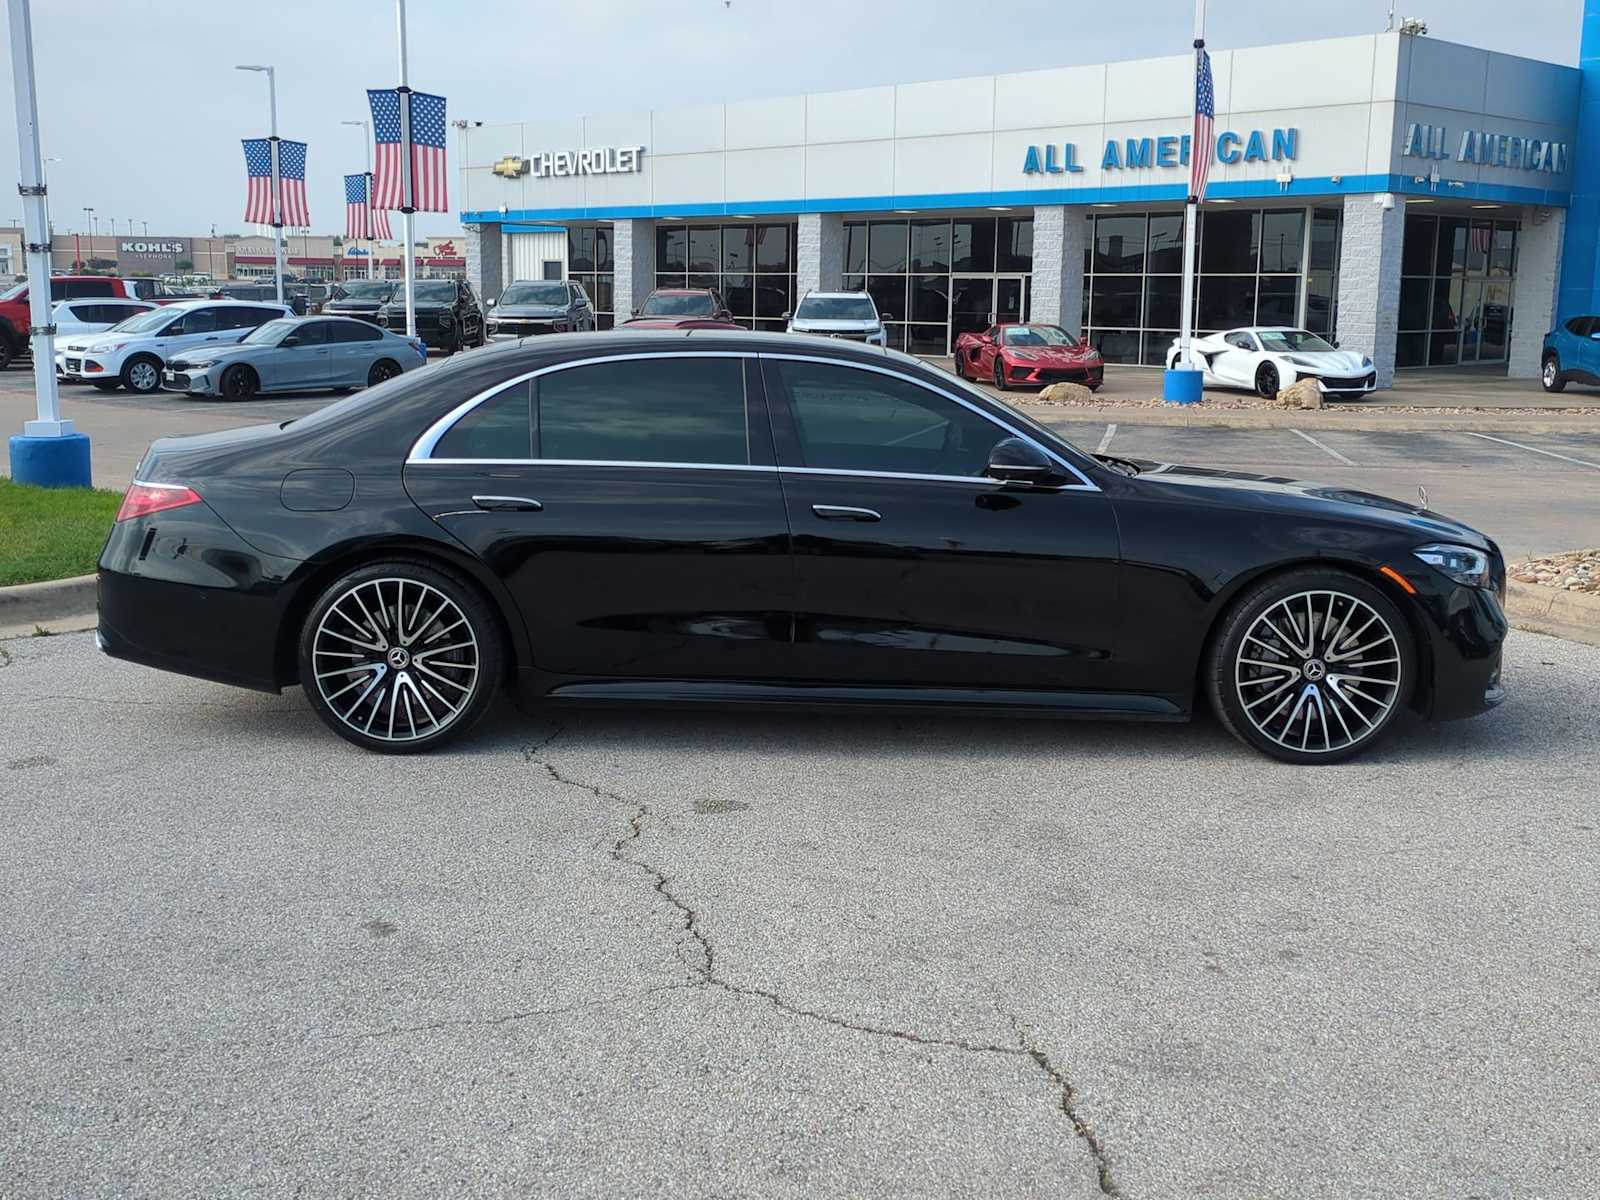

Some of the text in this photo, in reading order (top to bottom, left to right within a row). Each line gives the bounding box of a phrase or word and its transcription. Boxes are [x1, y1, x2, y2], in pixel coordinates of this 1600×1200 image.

[528, 146, 645, 178] CHEVROLET
[1023, 128, 1298, 174] ALL AMECAN
[1402, 123, 1568, 173] ALL AMERICAN
[121, 242, 184, 253] KOHL'S
